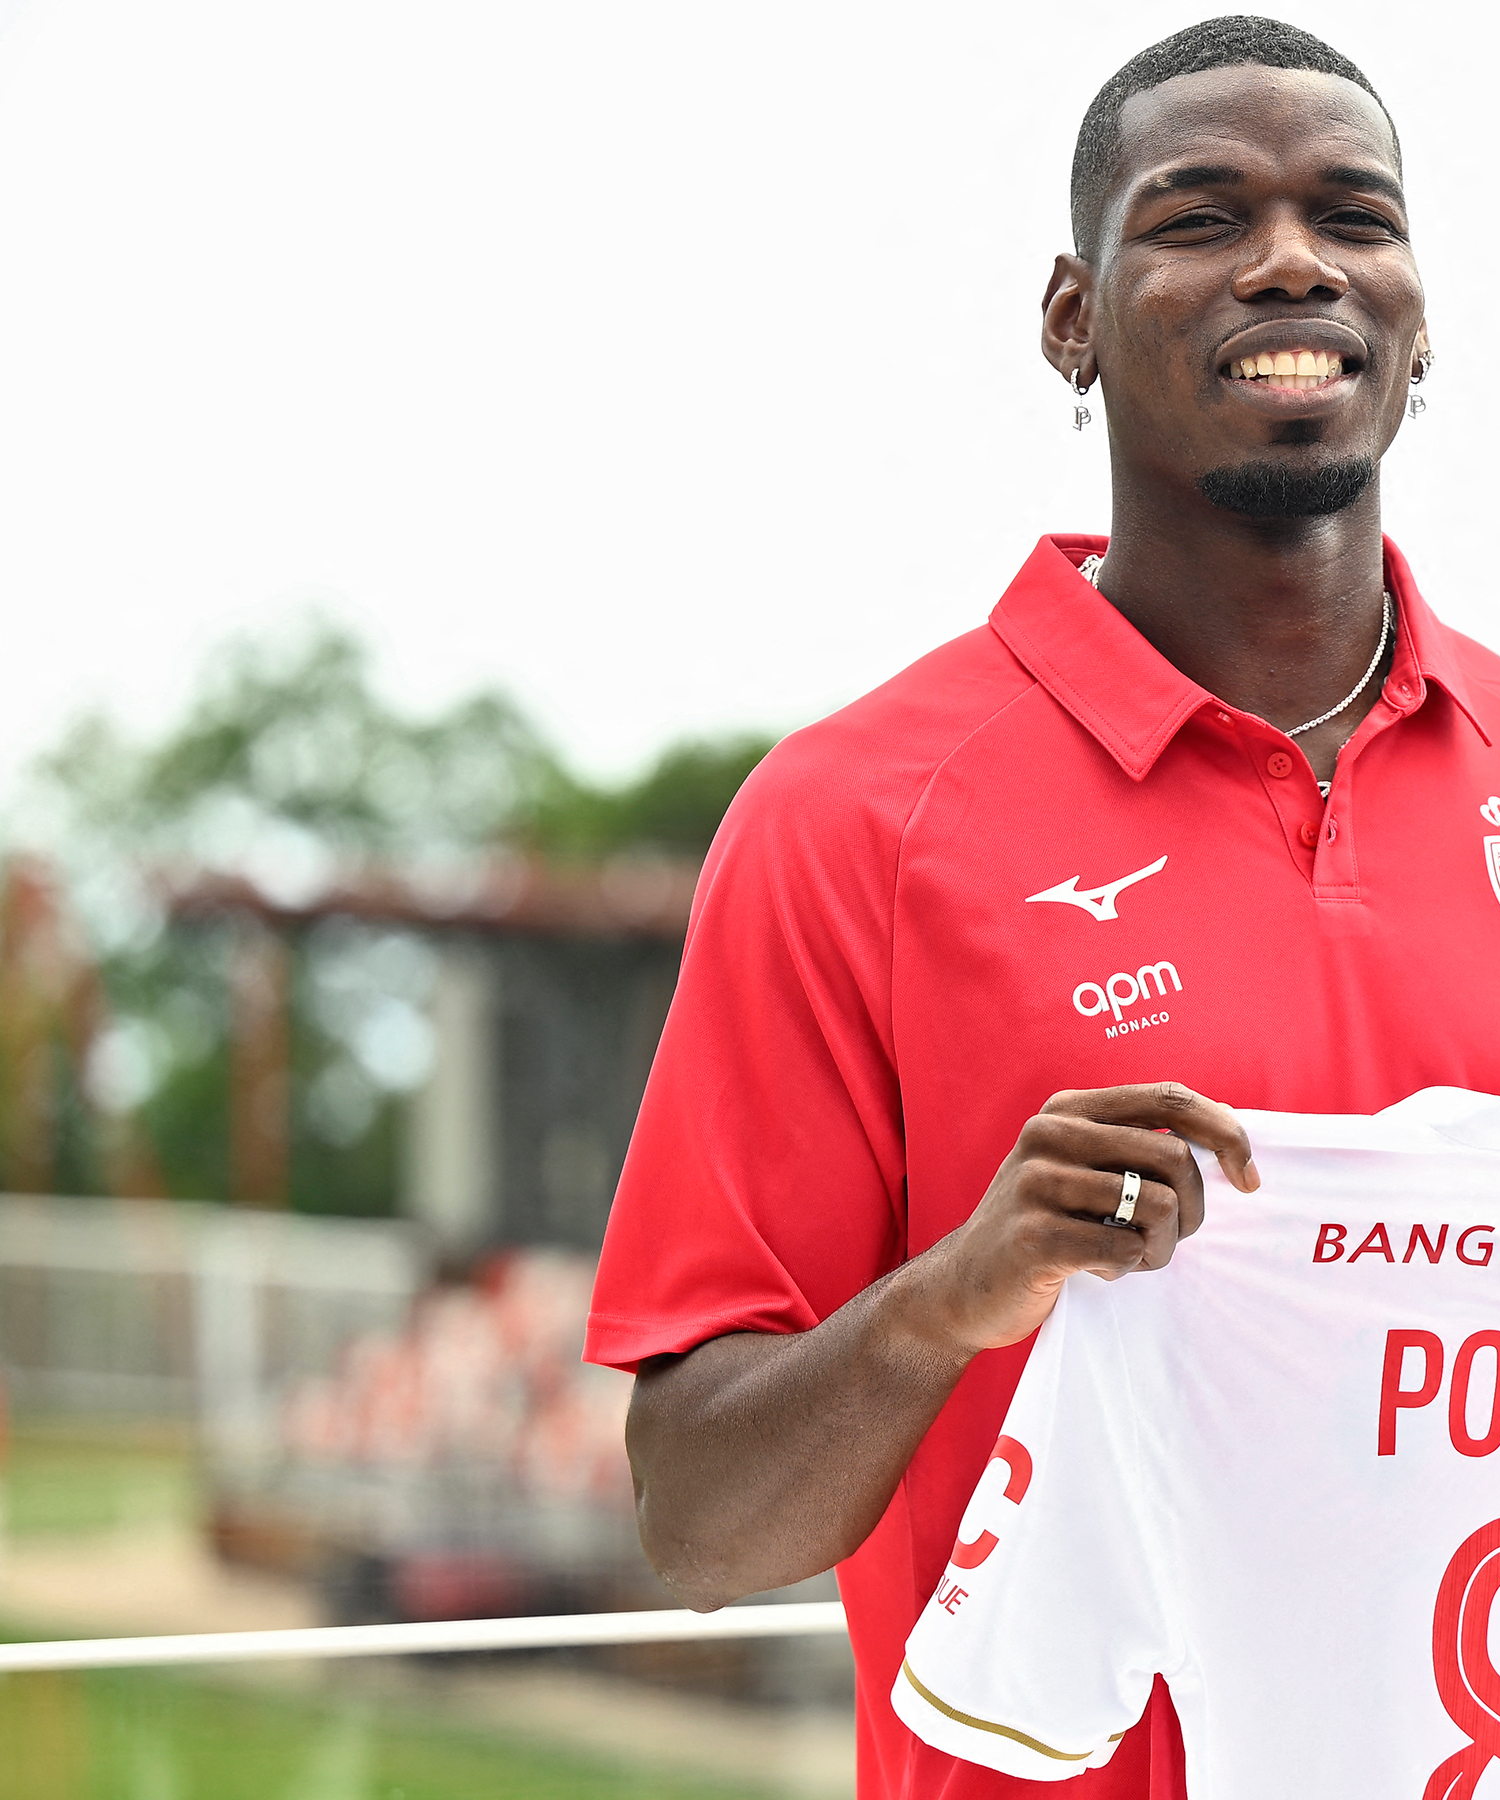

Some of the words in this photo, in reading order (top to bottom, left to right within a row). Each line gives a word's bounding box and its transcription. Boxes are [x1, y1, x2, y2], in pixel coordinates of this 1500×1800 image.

[1072, 960, 1183, 1021] apm
[1105, 1011, 1170, 1039] MONACO
[1312, 1222, 1496, 1267] BANG
